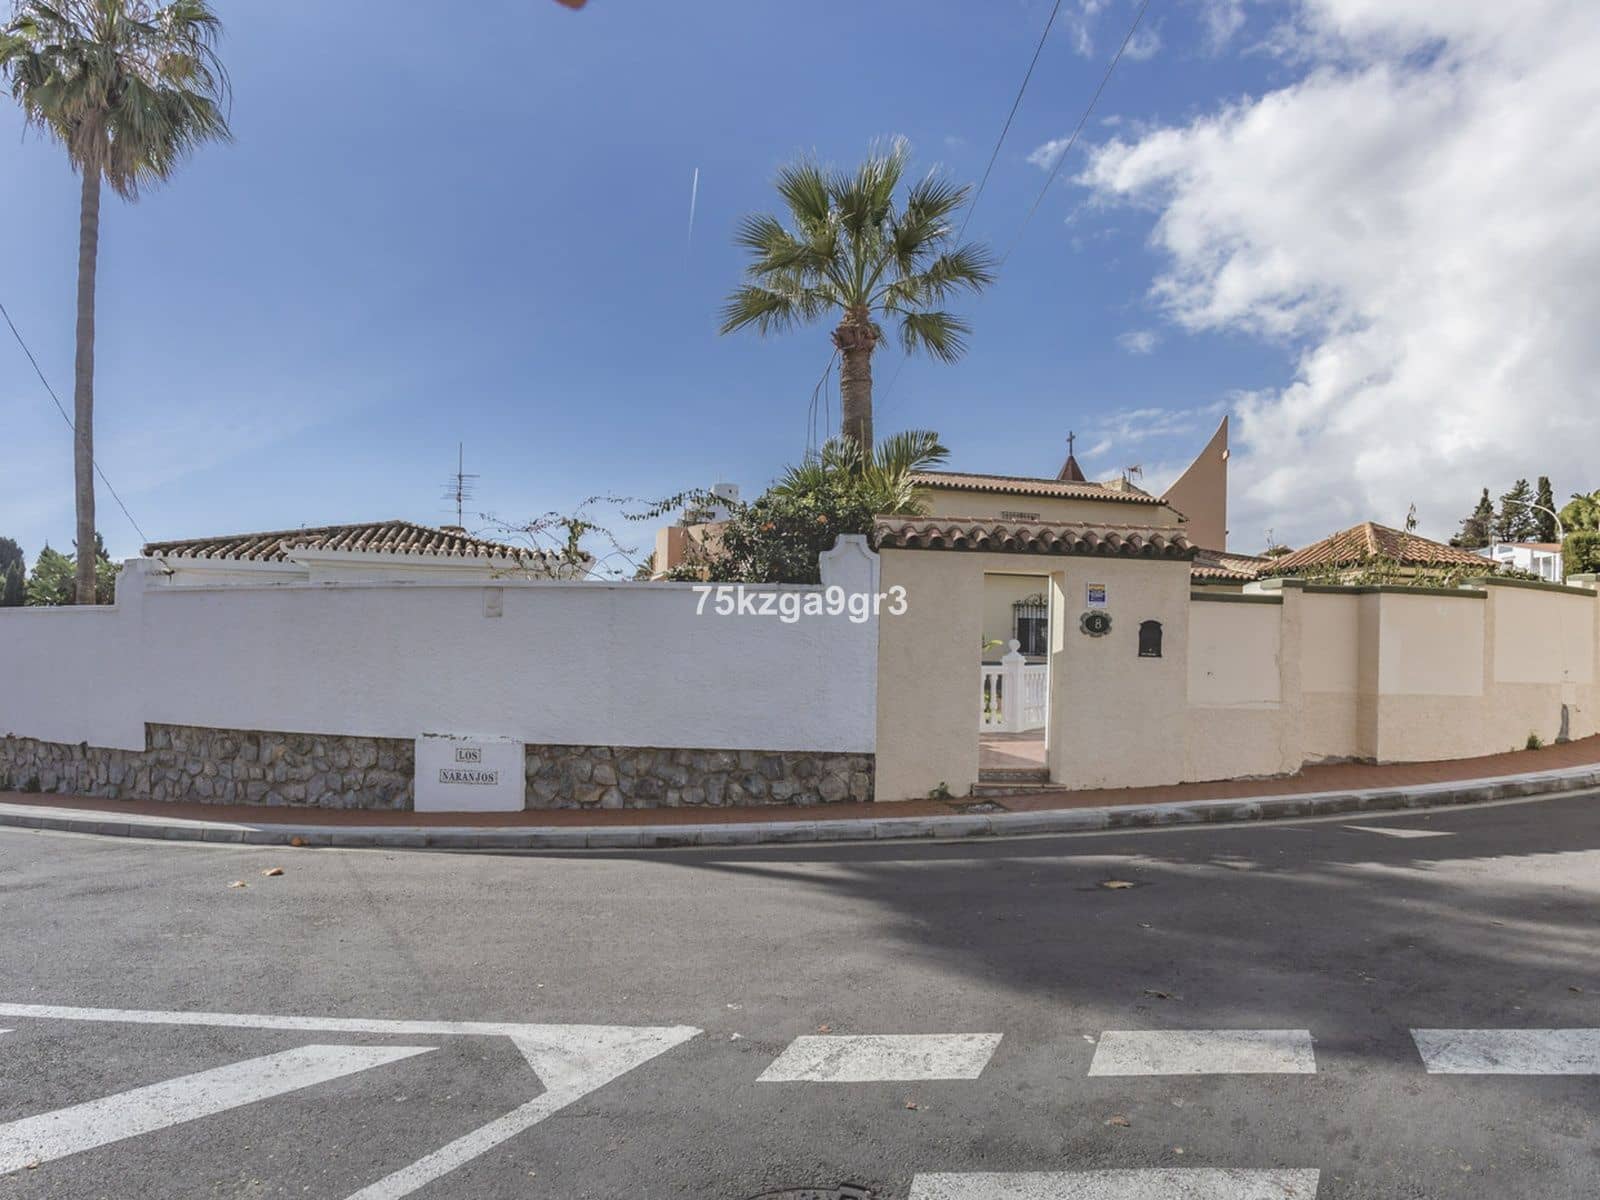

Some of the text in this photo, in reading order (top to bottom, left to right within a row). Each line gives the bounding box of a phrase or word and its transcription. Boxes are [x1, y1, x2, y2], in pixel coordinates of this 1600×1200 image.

[1094, 618, 1102, 629] 8
[458, 750, 478, 760] LOS
[442, 771, 495, 782] NARANJOS
